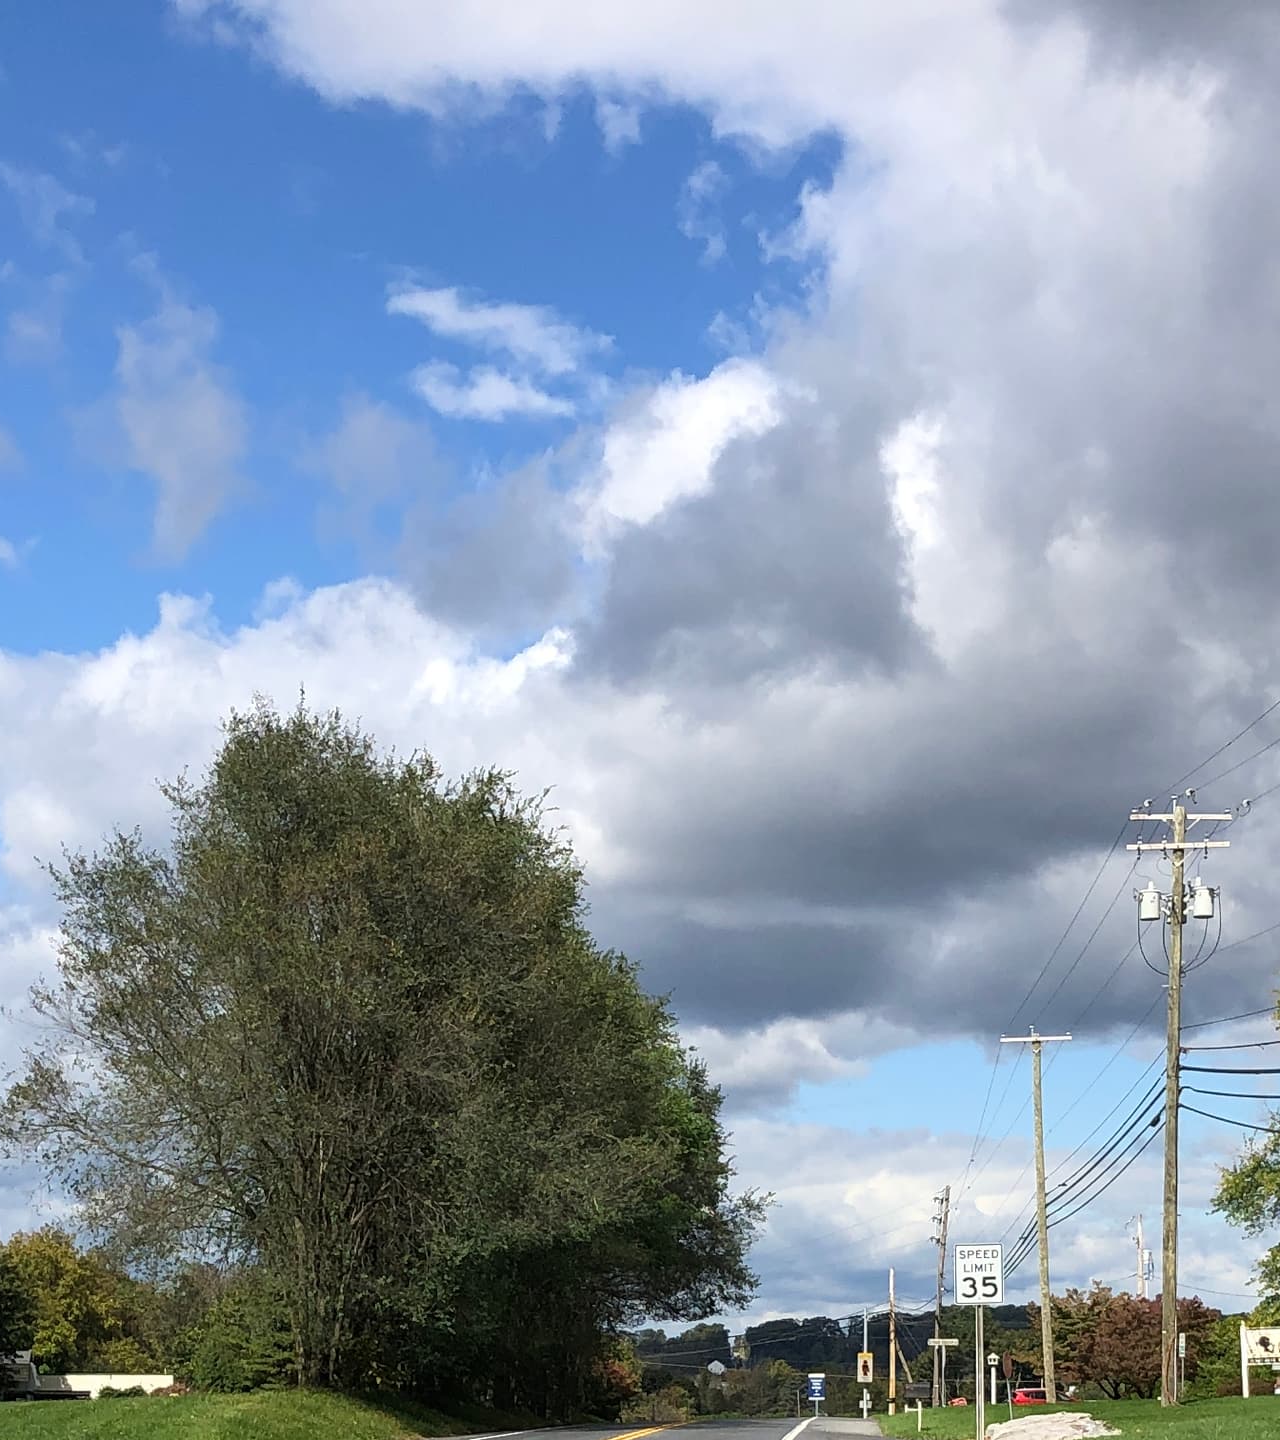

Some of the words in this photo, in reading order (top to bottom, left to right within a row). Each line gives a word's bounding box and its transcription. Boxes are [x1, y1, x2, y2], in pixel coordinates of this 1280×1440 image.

[959, 1249, 999, 1259] SPEED
[963, 1263, 995, 1273] LIMIT
[961, 1276, 998, 1298] 35
